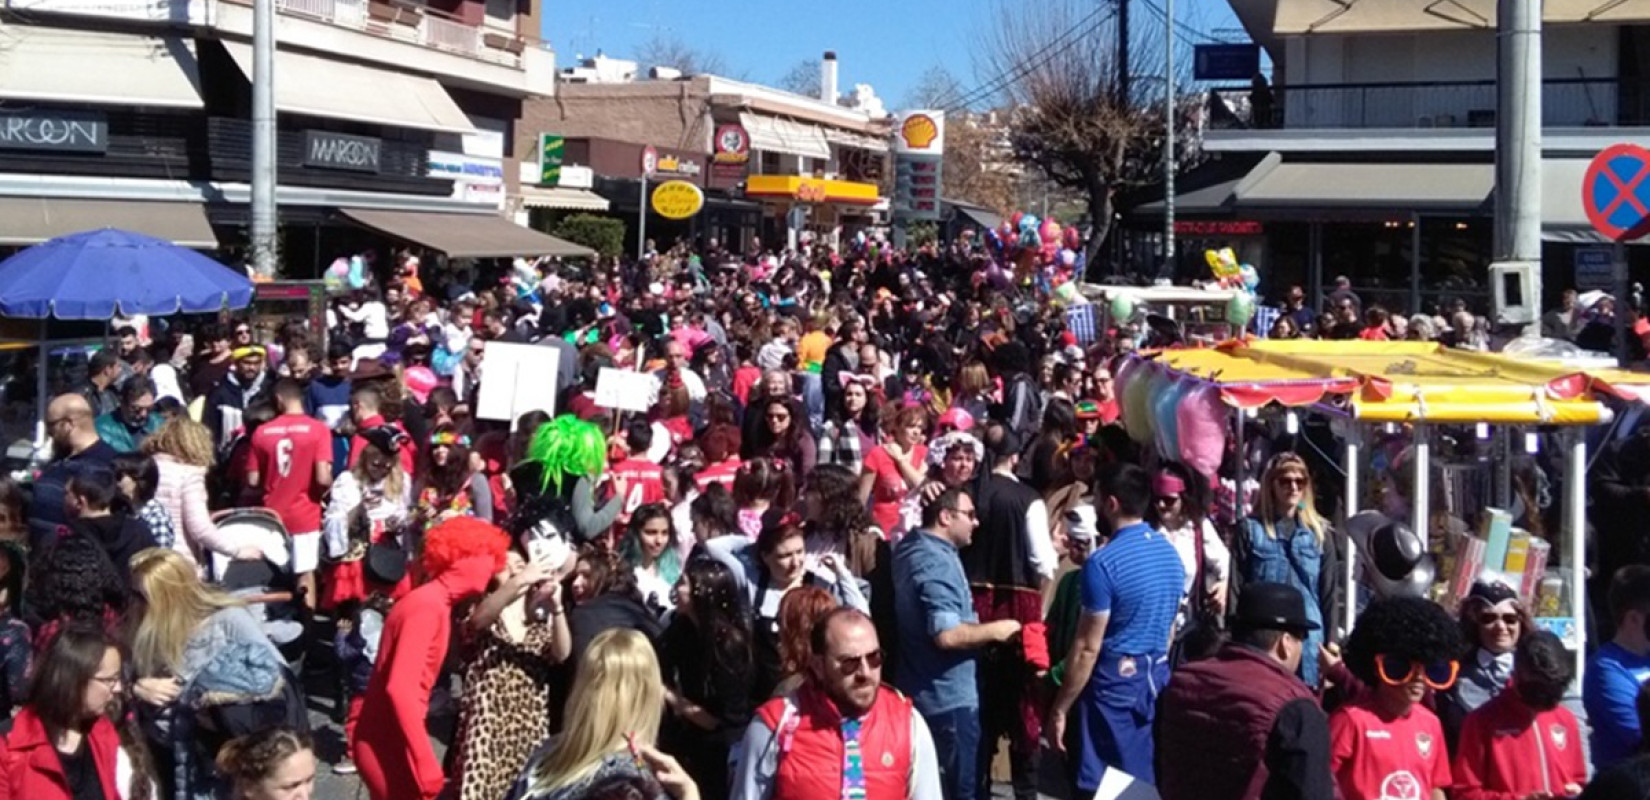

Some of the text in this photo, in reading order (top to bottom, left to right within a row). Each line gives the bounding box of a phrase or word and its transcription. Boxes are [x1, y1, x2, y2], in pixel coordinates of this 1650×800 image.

[0, 117, 97, 145] ROON
[311, 138, 379, 166] MAROON
[276, 437, 293, 478] 6
